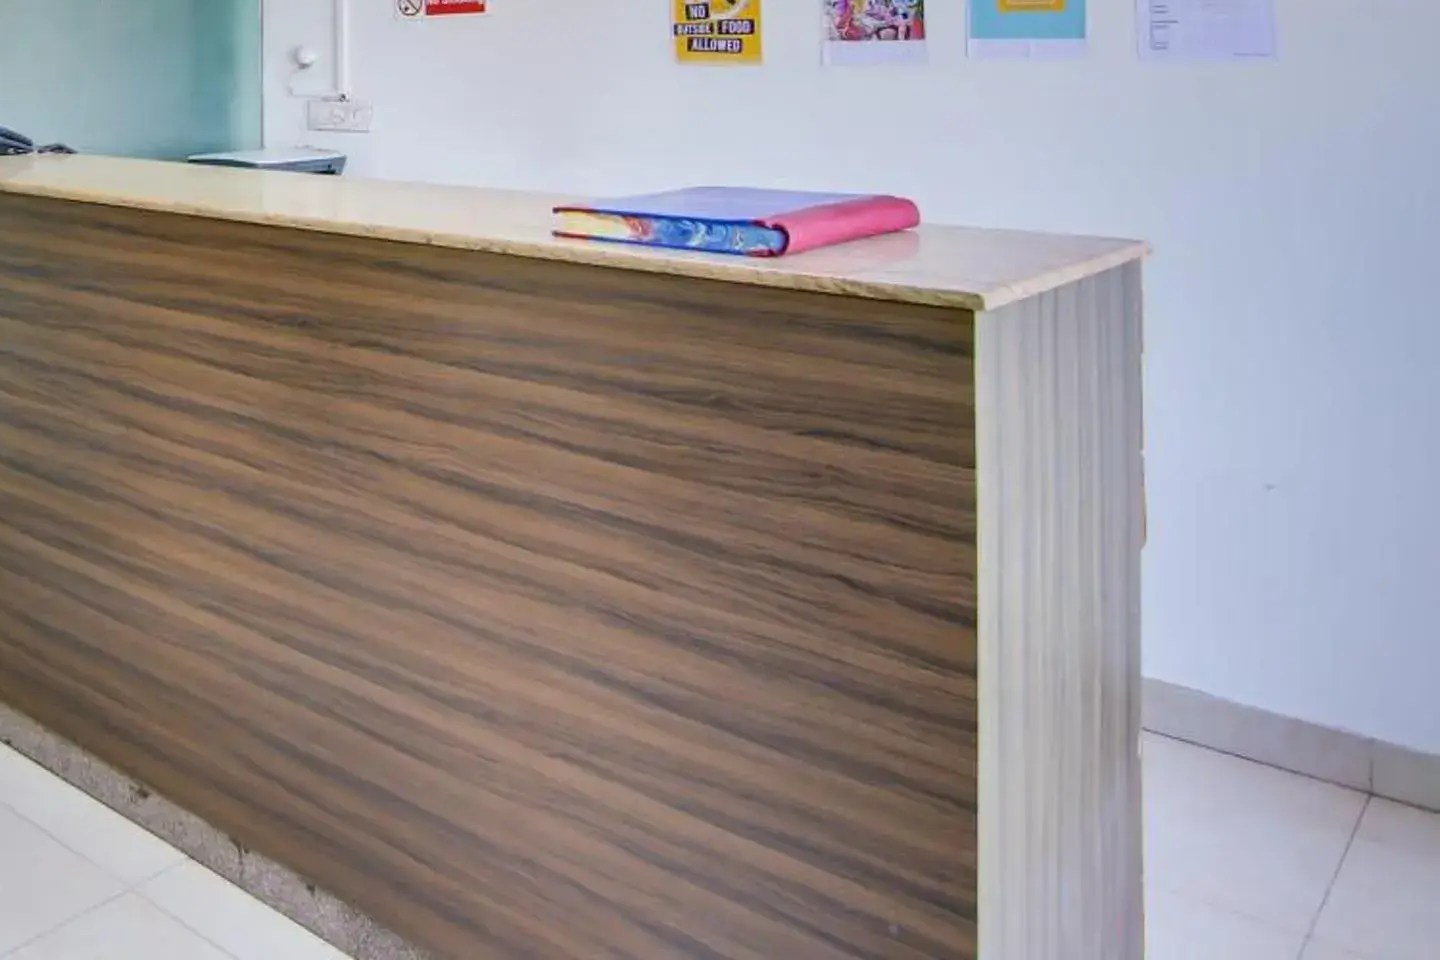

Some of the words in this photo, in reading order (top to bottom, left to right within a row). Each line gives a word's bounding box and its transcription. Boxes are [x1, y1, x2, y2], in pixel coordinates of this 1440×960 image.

[689, 5, 706, 18] NO
[721, 20, 751, 33] FOOD
[691, 38, 741, 52] ALLOWED
